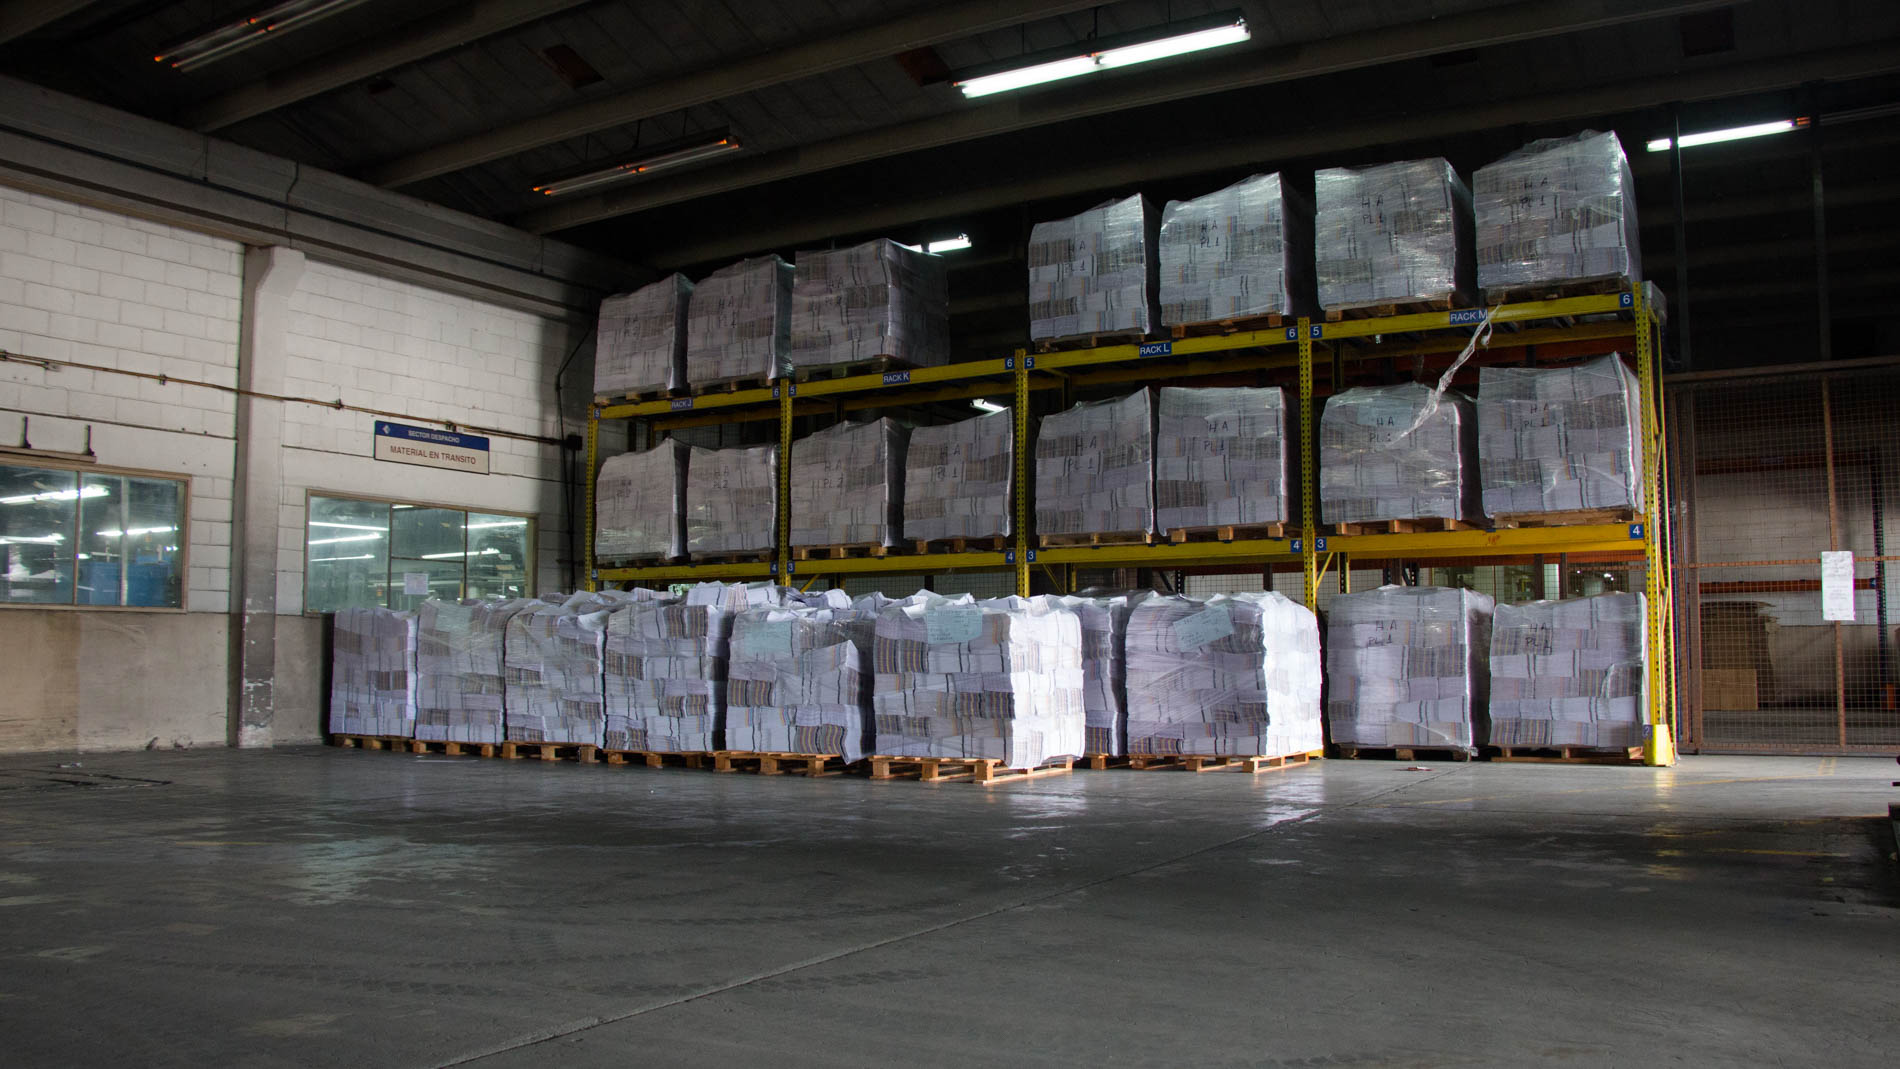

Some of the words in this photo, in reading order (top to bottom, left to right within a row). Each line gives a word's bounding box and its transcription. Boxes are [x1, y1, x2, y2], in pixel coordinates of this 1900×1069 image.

[1623, 294, 1631, 305] 6
[1450, 312, 1477, 323] RACK
[1478, 309, 1488, 320] M
[1288, 327, 1296, 338] 6
[1313, 326, 1320, 337] 5
[1140, 345, 1162, 356] RACK
[1163, 343, 1170, 353] L
[1007, 358, 1013, 368] 6
[1026, 357, 1033, 367] 5
[883, 374, 902, 383] RACK
[903, 372, 910, 381] K
[774, 387, 780, 396] 6
[790, 385, 796, 395] 5
[408, 429, 430, 439] SECTOR
[431, 432, 460, 443] DESPACHO
[390, 445, 427, 458] MATERIAL
[429, 450, 440, 460] EN
[441, 452, 477, 465] TRANSITO
[1631, 525, 1641, 537] 4
[1292, 540, 1300, 550] 4
[1317, 538, 1324, 549] 3
[1006, 552, 1014, 561] 4
[1027, 550, 1034, 560] 3
[771, 563, 777, 572] 4
[788, 562, 794, 572] 3
